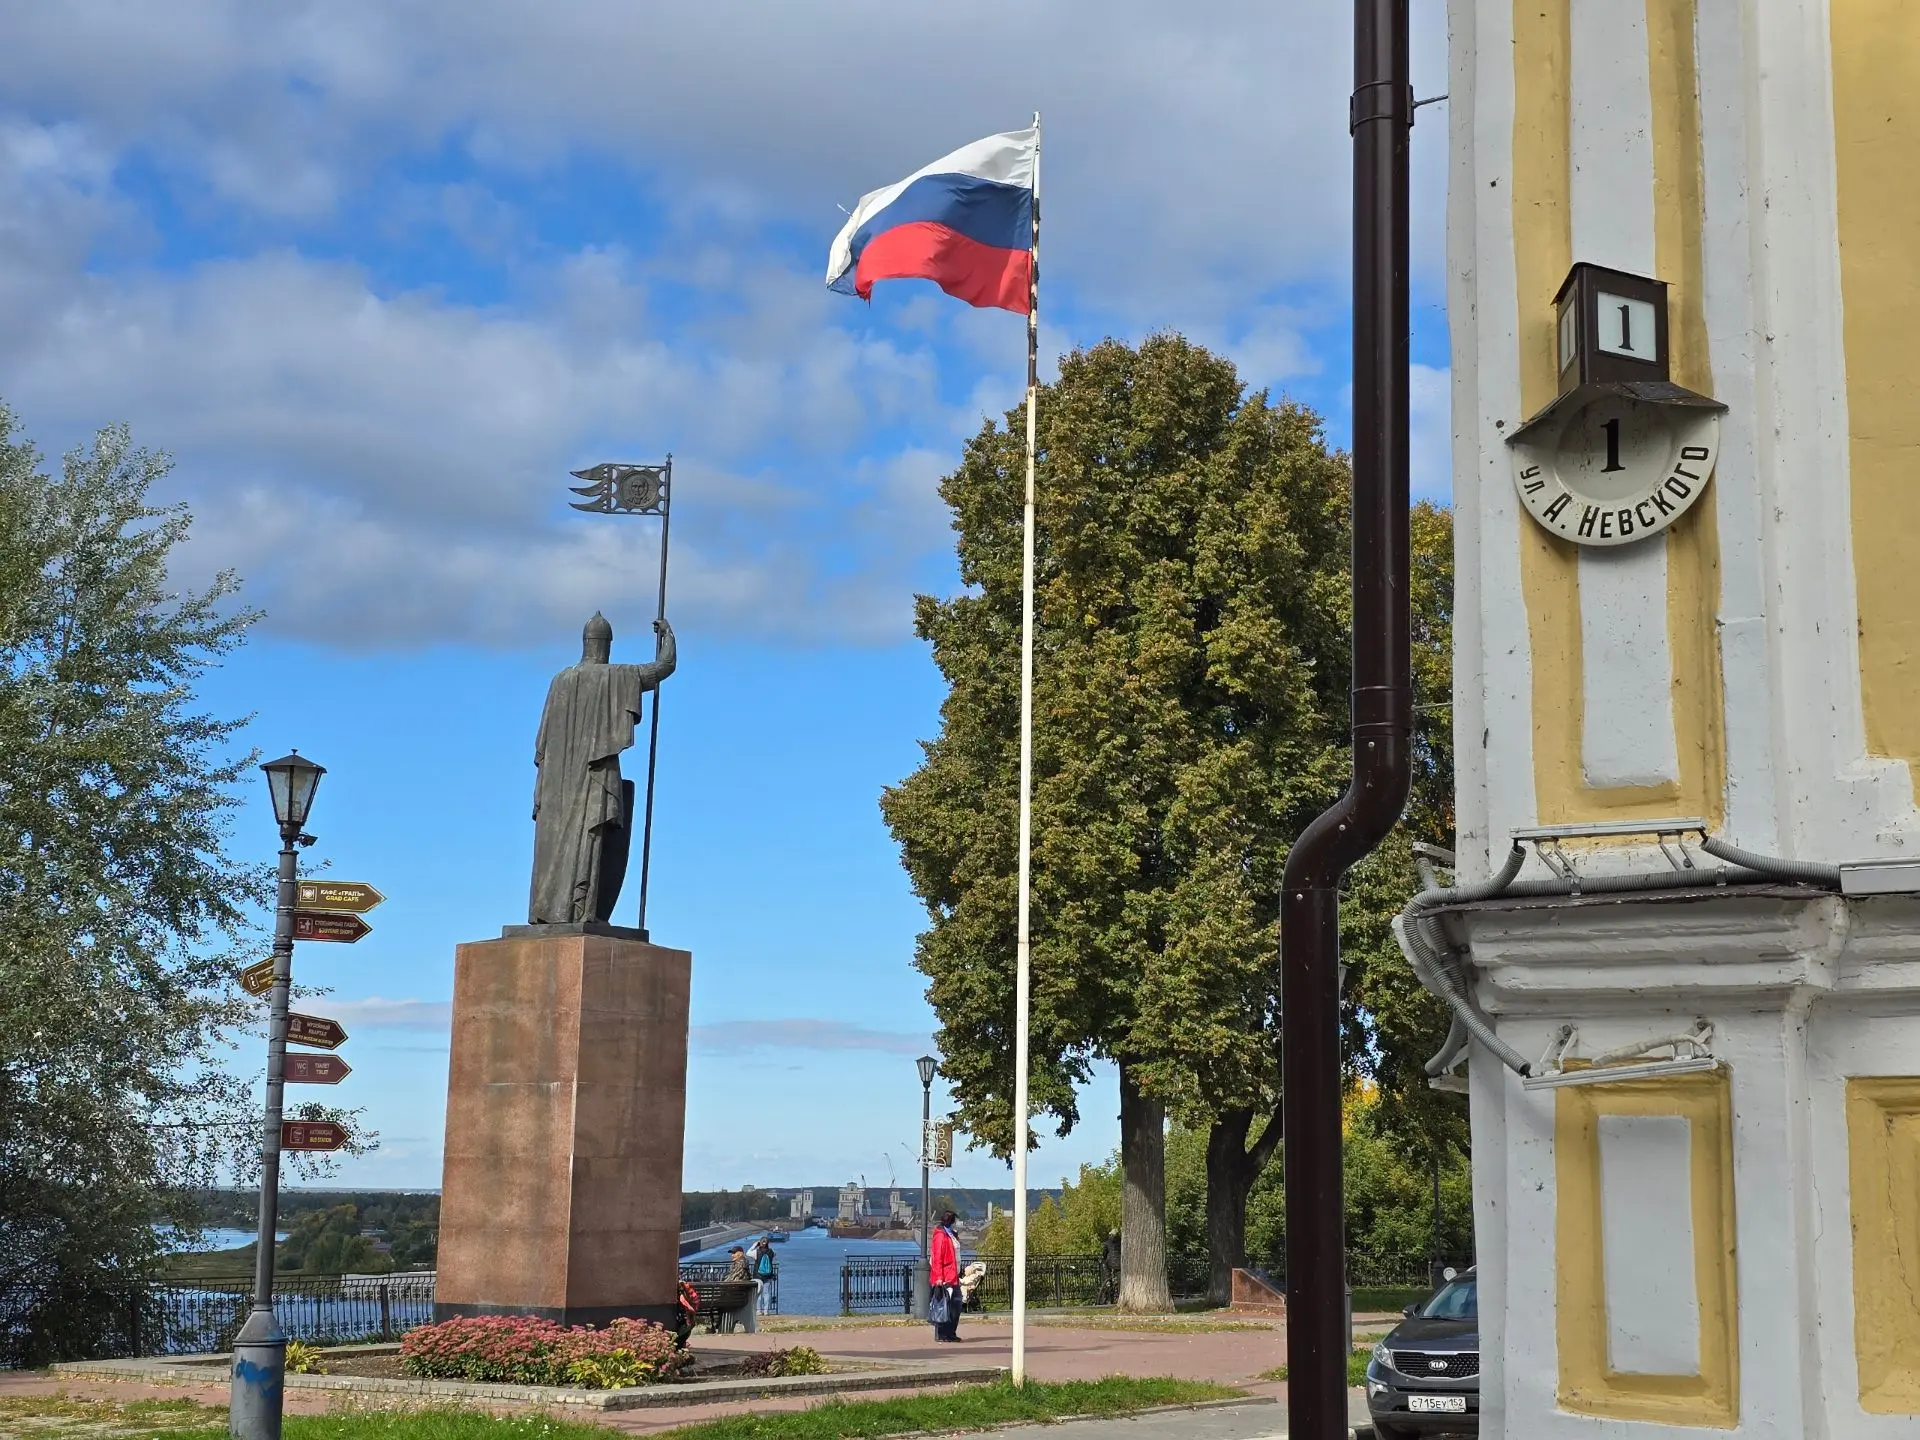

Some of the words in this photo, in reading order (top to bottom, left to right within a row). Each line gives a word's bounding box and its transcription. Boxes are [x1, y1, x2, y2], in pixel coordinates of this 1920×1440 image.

[1616, 304, 1634, 351] 1
[1600, 418, 1626, 473] 1
[1543, 492, 1573, 529] А.
[1577, 446, 1709, 539] НЕВСКОГО
[296, 1062, 307, 1070] WC
[1448, 1398, 1463, 1407] 152
